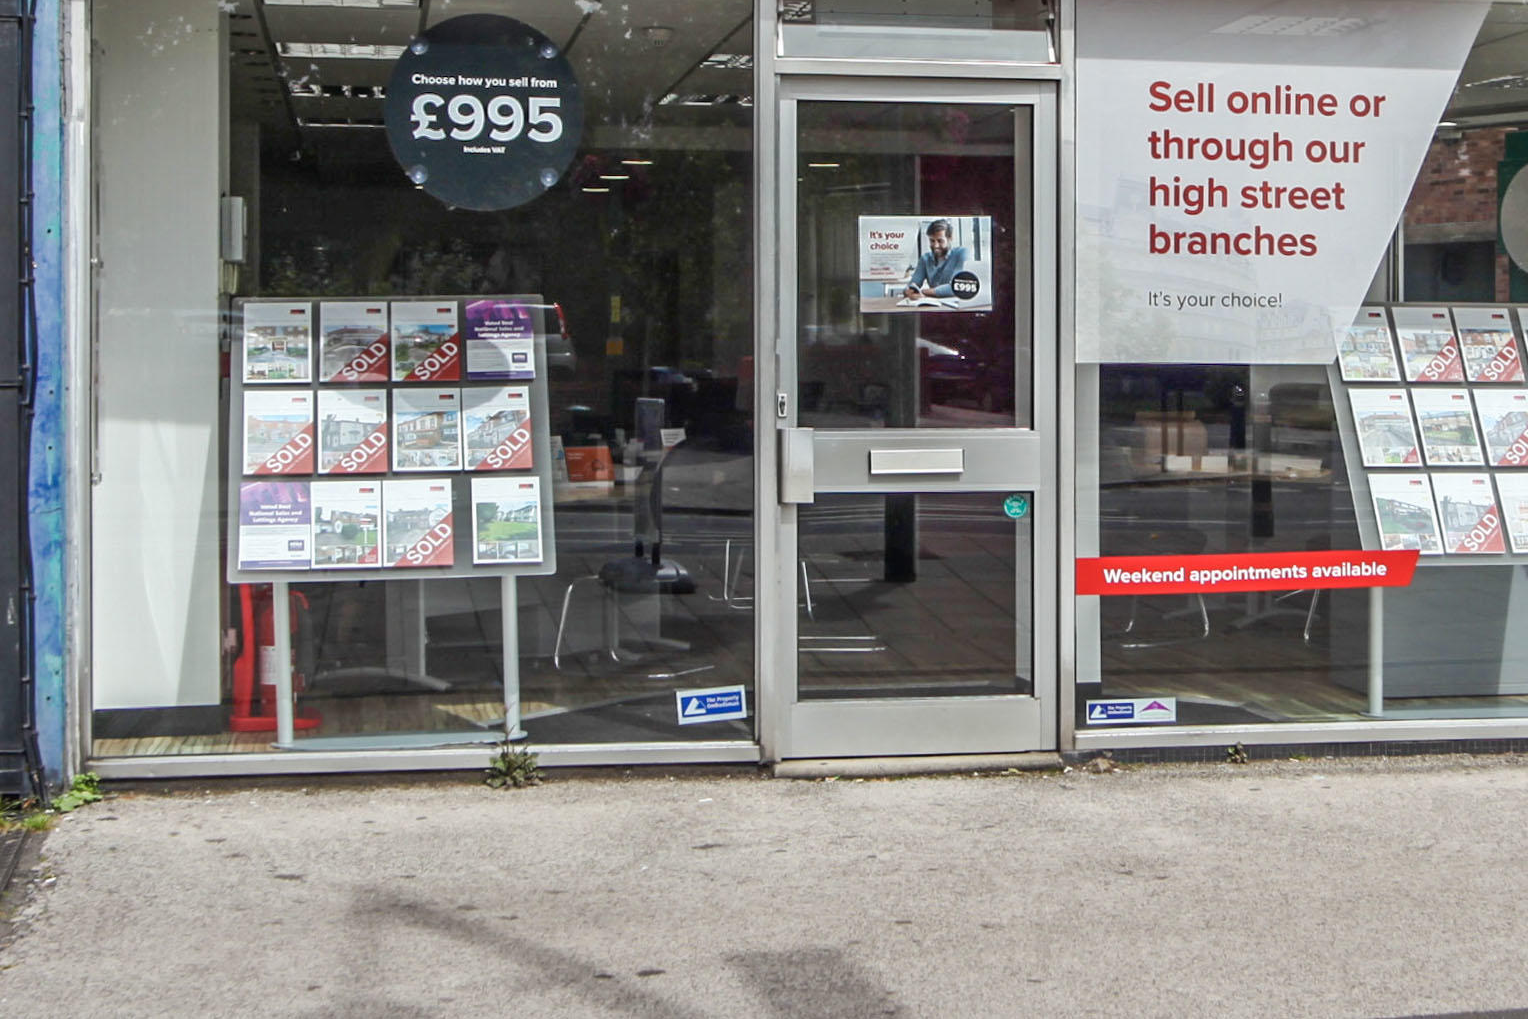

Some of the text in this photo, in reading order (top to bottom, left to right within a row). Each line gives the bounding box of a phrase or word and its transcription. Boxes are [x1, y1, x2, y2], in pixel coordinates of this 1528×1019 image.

[411, 74, 557, 88] Choose how you sell from
[1149, 81, 1386, 117] Sell online or
[410, 93, 563, 143] £995
[463, 146, 491, 154] Includes
[1148, 129, 1366, 169] through our
[1149, 176, 1345, 215] high street
[870, 242, 899, 250] choice
[885, 232, 905, 240] your
[1149, 224, 1318, 257] branches
[954, 283, 977, 292] £995
[1177, 294, 1216, 310] your
[1221, 292, 1282, 308] choice!
[342, 343, 387, 380] SOLD
[414, 342, 458, 380] SOLD
[1424, 345, 1457, 381] SOLD
[1484, 345, 1516, 381] SOLD
[266, 433, 312, 473] SOLD
[341, 432, 386, 471] SOLD
[486, 427, 531, 469] SOLD
[406, 521, 452, 565] SOLD
[1464, 513, 1497, 552] SOLD
[1103, 561, 1387, 585] Weekend appointments available
